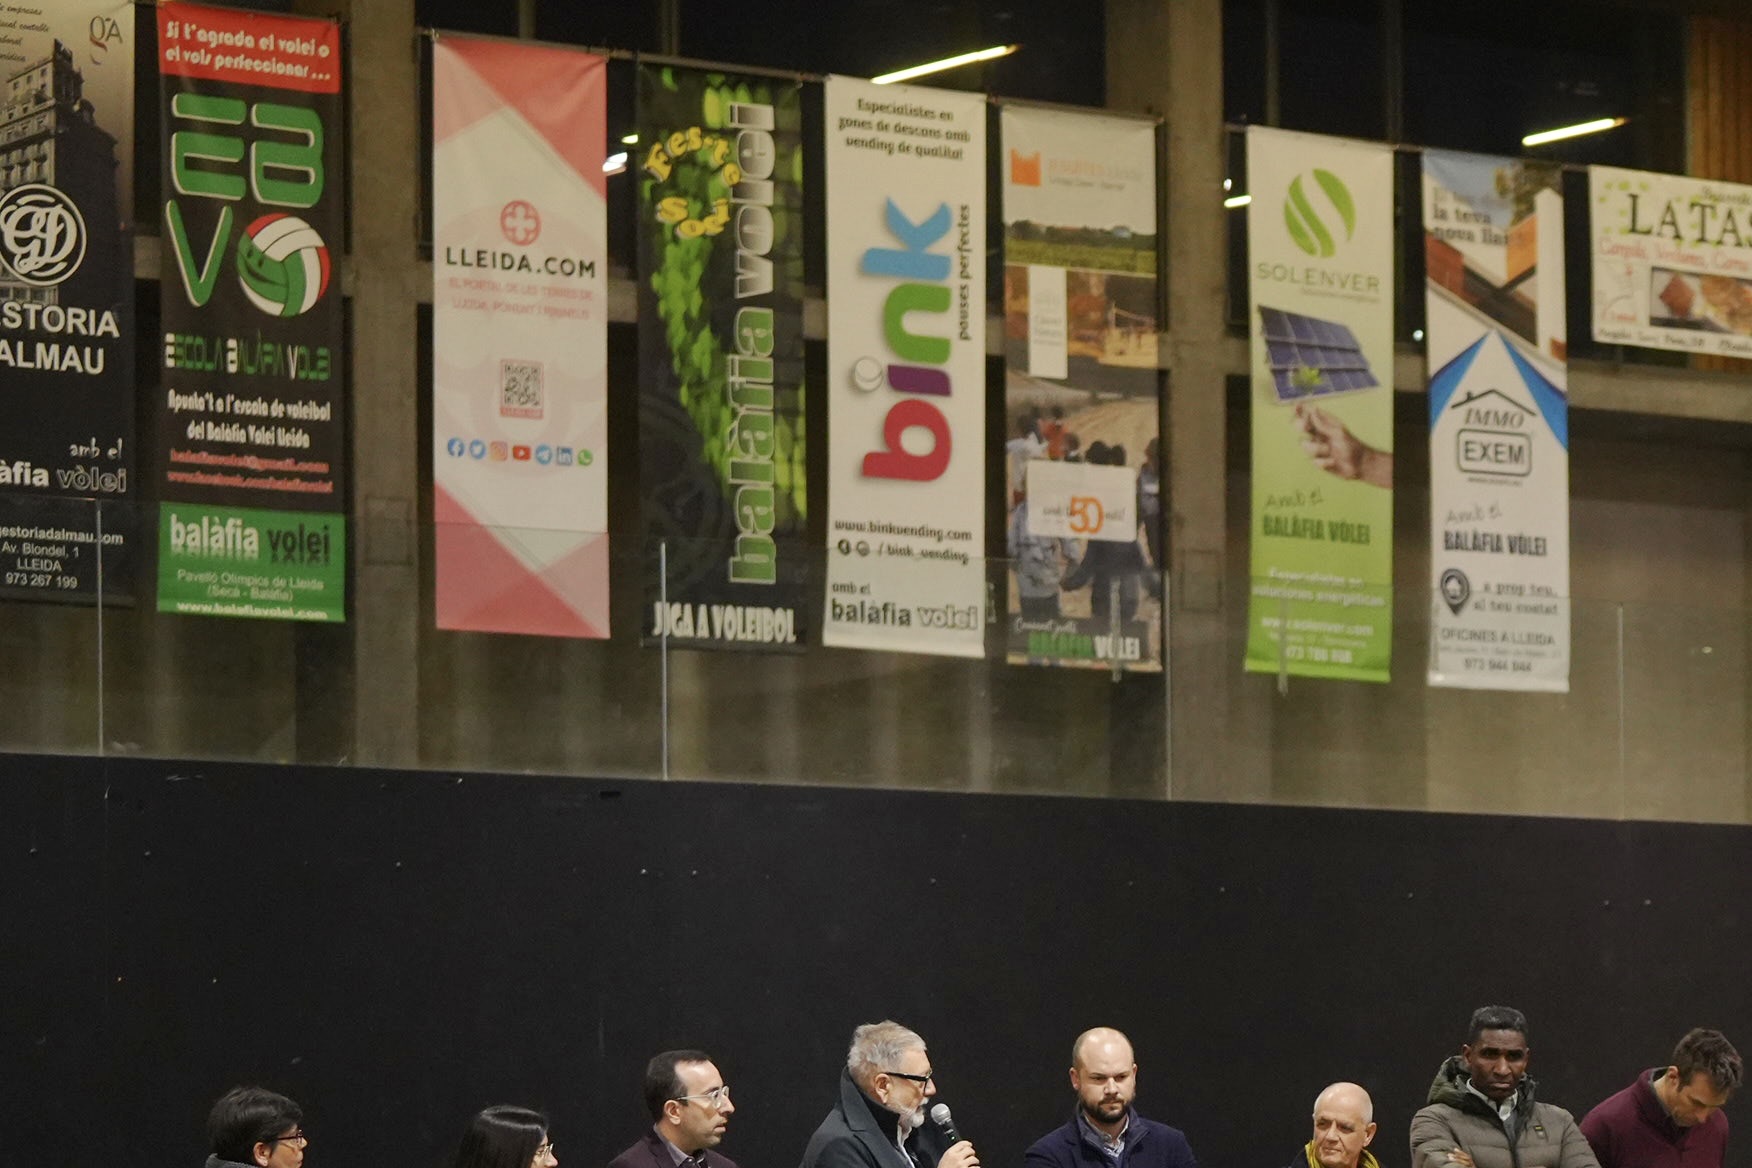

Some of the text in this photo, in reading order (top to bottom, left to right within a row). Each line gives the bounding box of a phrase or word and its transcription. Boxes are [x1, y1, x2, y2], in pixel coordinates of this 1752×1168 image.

[166, 21, 180, 38] Si
[259, 34, 275, 50] el
[279, 37, 315, 55] volei
[318, 44, 330, 58] o
[165, 46, 180, 62] el
[184, 48, 211, 66] vols
[857, 98, 954, 121] Especialistes en
[877, 119, 890, 132] de
[846, 136, 894, 156] vending
[898, 140, 911, 152] de
[446, 247, 596, 279] LLEIDA.COM
[1257, 262, 1380, 294] SOLENVER
[0, 302, 120, 338] STORIA
[851, 195, 953, 484] bink
[1465, 407, 1525, 429] IMMO
[69, 437, 123, 459] amb el
[1464, 440, 1525, 465] EXEM
[0, 526, 123, 545] estoriadalmau.om
[170, 513, 259, 552] balàfia
[16, 558, 62, 572] LLEIDA
[6, 572, 28, 585] 973
[653, 601, 797, 644] JUGA A VOLEIBOL
